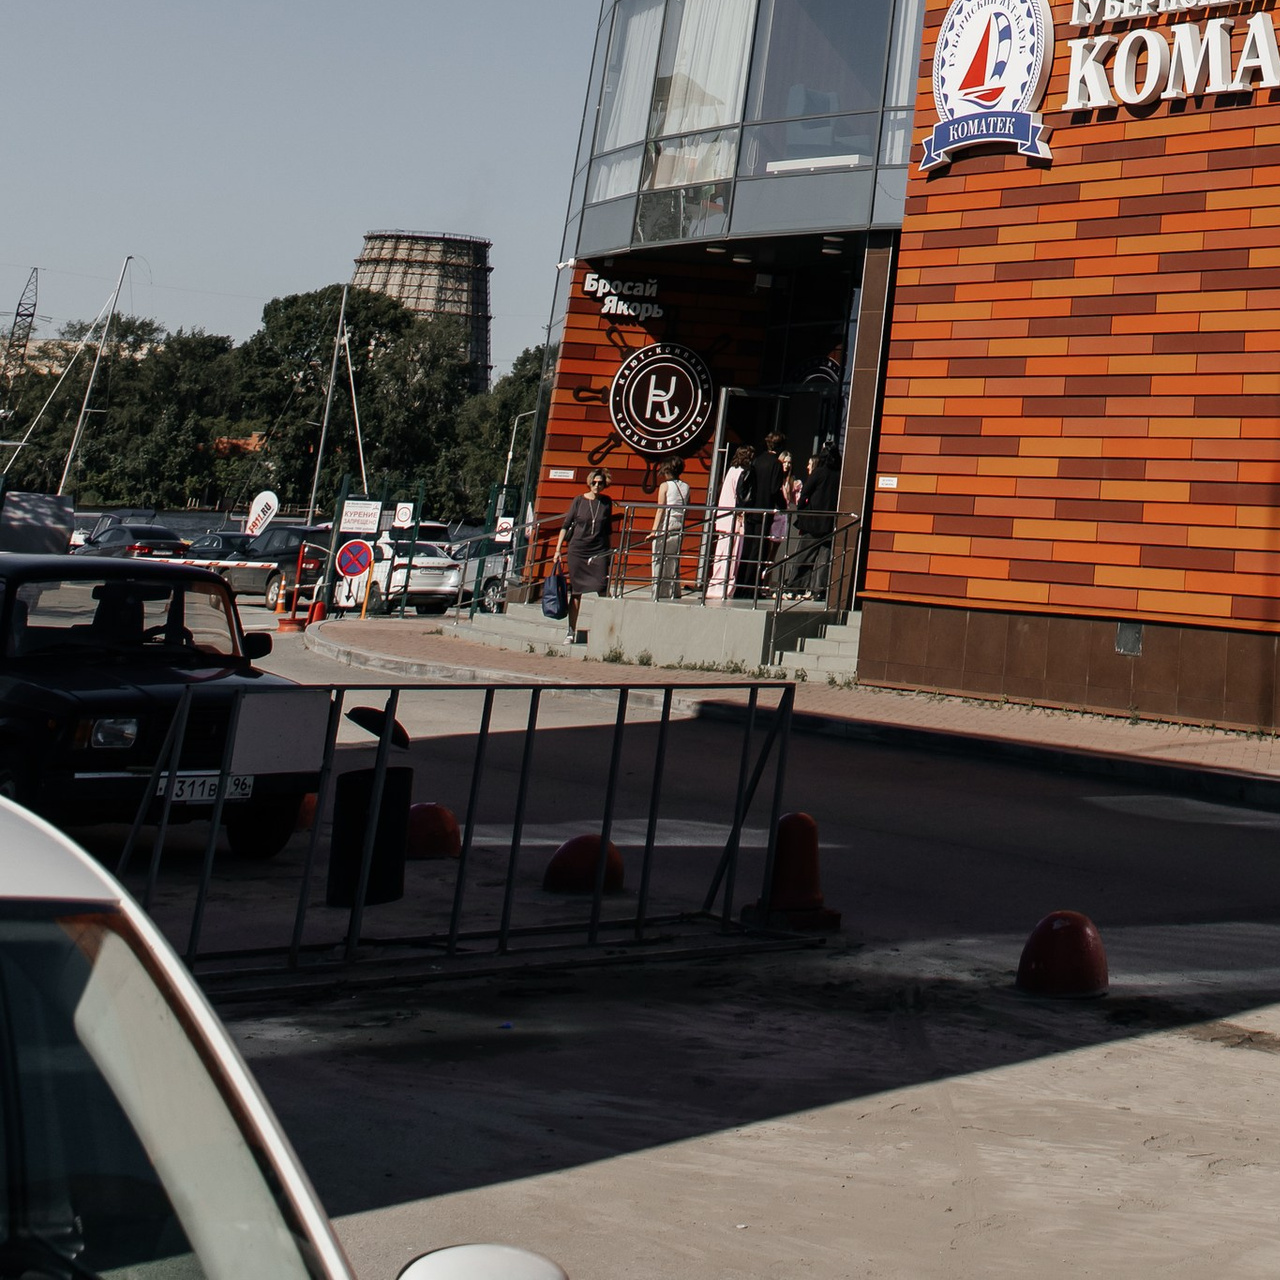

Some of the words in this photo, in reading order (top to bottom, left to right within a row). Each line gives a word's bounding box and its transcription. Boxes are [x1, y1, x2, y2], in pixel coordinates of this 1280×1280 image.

[948, 117, 1016, 142] КОМАТЕК
[583, 273, 658, 297] Бросай
[601, 295, 664, 321] Якорь
[616, 412, 647, 446] ЯКОРЬ
[656, 416, 703, 450] БРОСАЙ
[344, 510, 378, 518] КУРЕНИЕ
